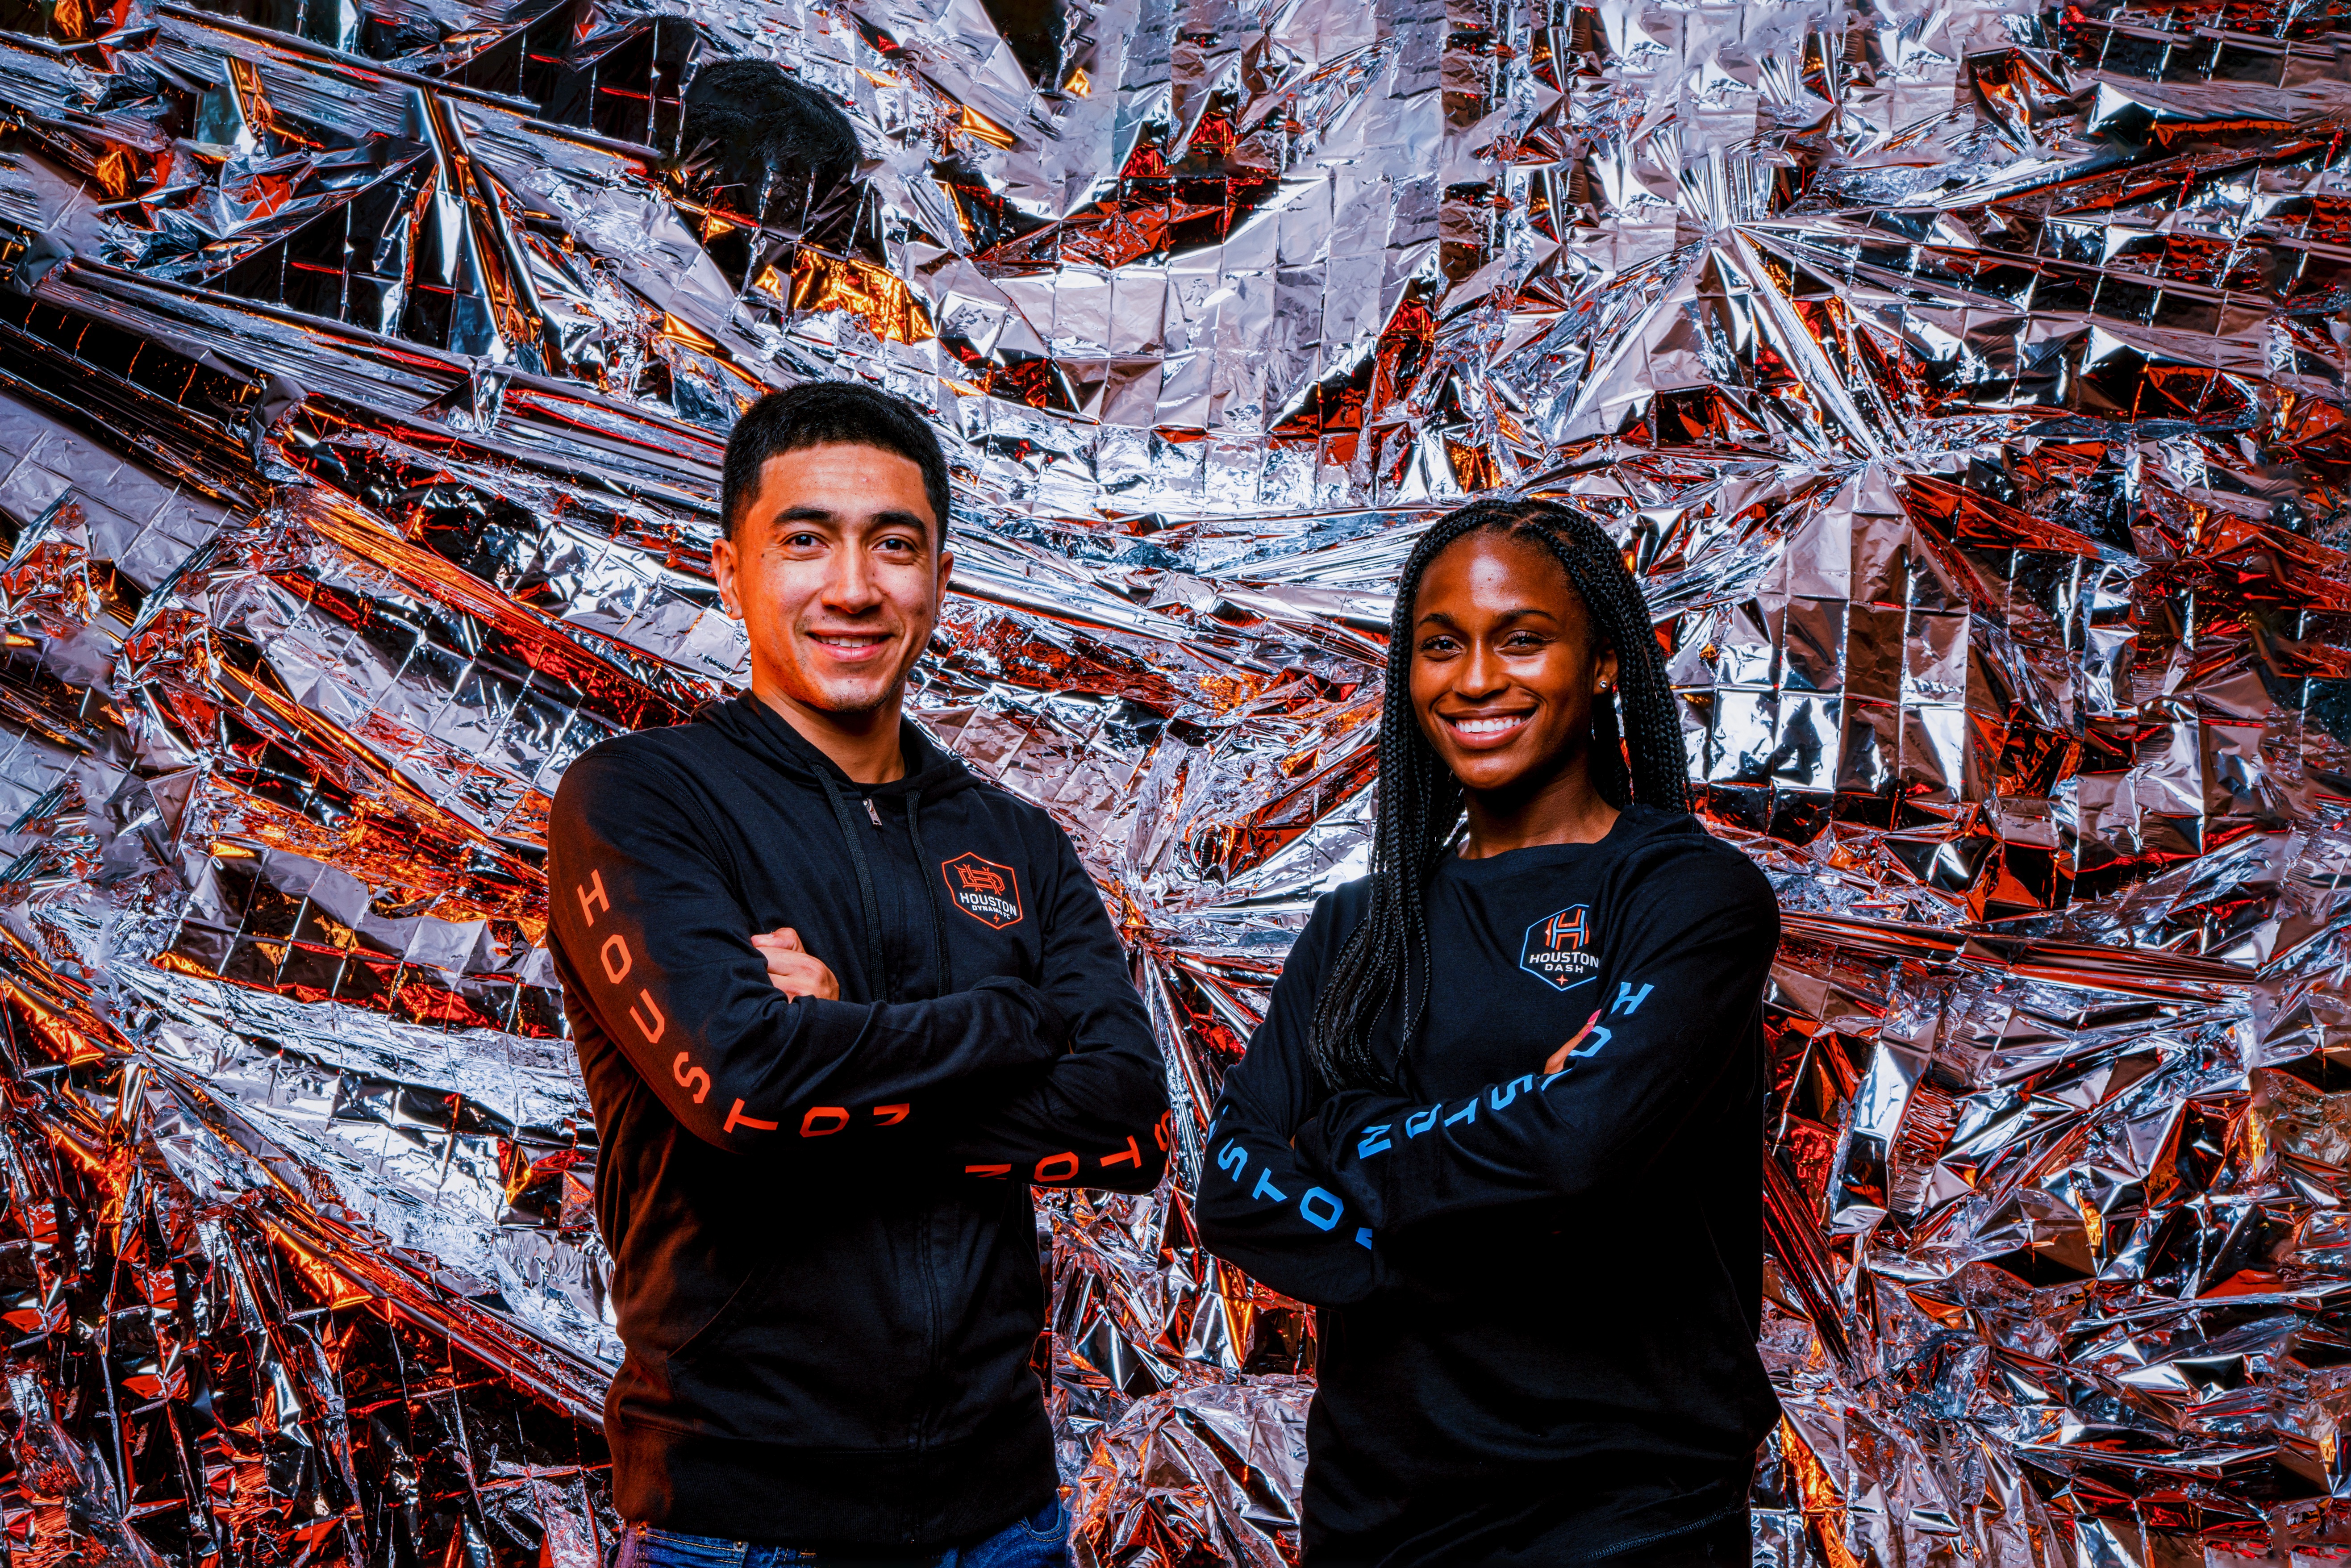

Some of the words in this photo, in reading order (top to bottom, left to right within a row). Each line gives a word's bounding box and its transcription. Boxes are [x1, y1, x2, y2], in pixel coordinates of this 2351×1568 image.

[959, 892, 1017, 917] HOUSTON
[971, 905, 1003, 915] DYNAMO
[1003, 912, 1011, 920] FC
[1529, 952, 1600, 968] HOUSTON
[1544, 963, 1584, 974] DASH
